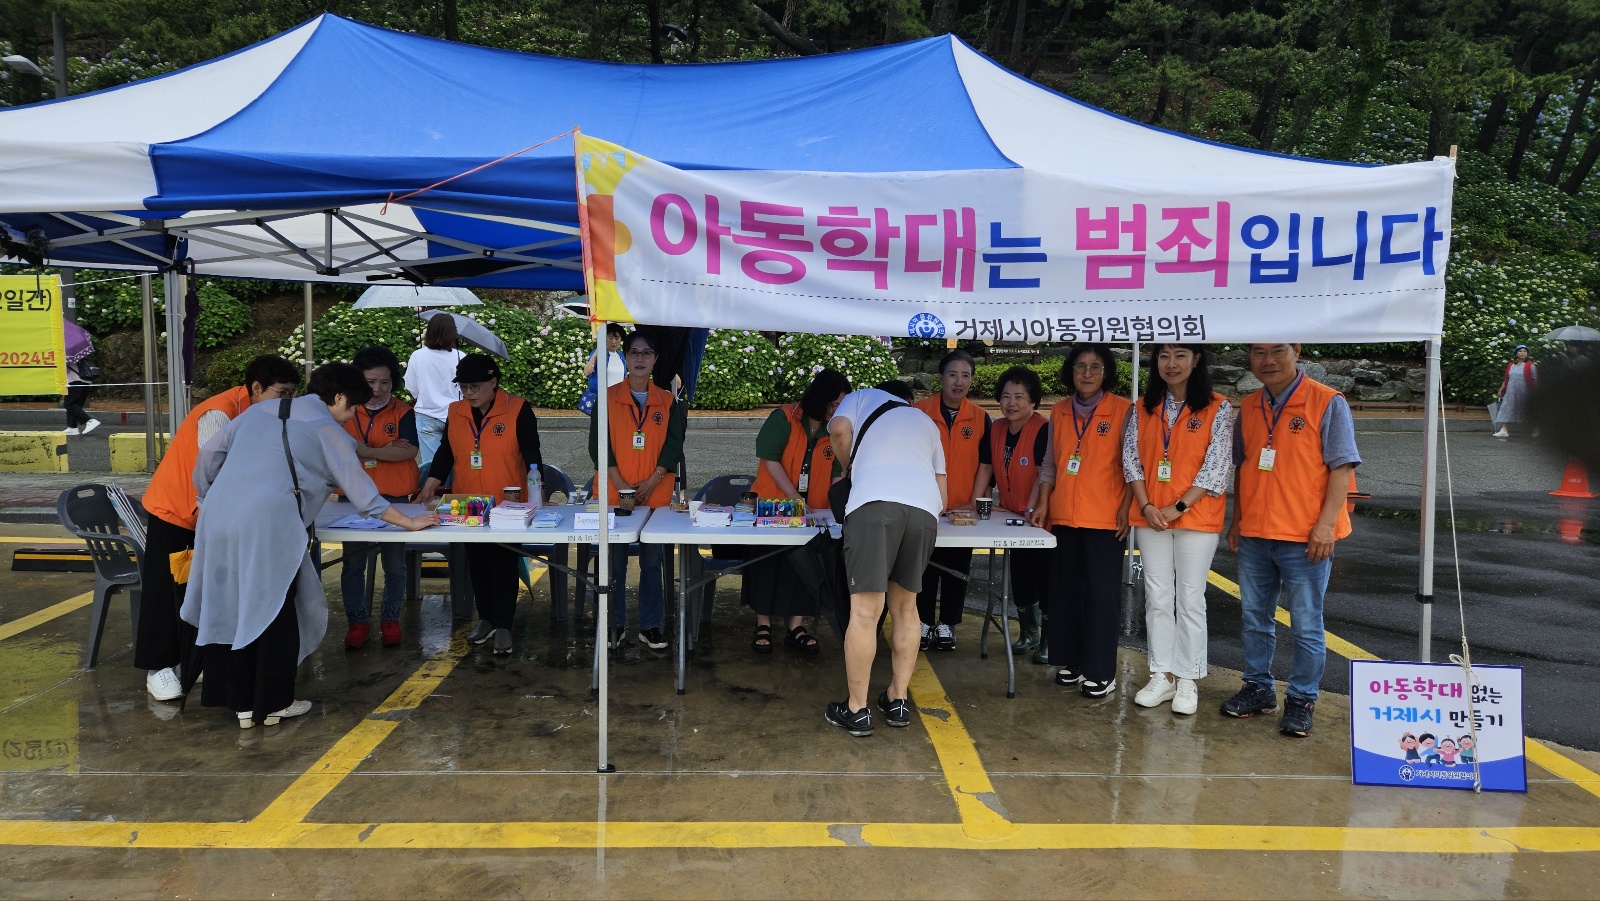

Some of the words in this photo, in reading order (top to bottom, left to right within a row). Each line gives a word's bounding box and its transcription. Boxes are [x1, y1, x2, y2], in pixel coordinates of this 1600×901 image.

[650, 193, 1047, 292] 아동학대는
[1075, 201, 1443, 290] 범죄입니다
[0, 289, 51, 312] 일간)
[955, 314, 1207, 341] 거제시아동위원협의회
[0, 351, 55, 366] 2024년
[1369, 677, 1462, 700] 아동학대
[1471, 684, 1502, 704] 없는
[1369, 706, 1441, 723] 거제시
[1449, 709, 1503, 731] 만들기
